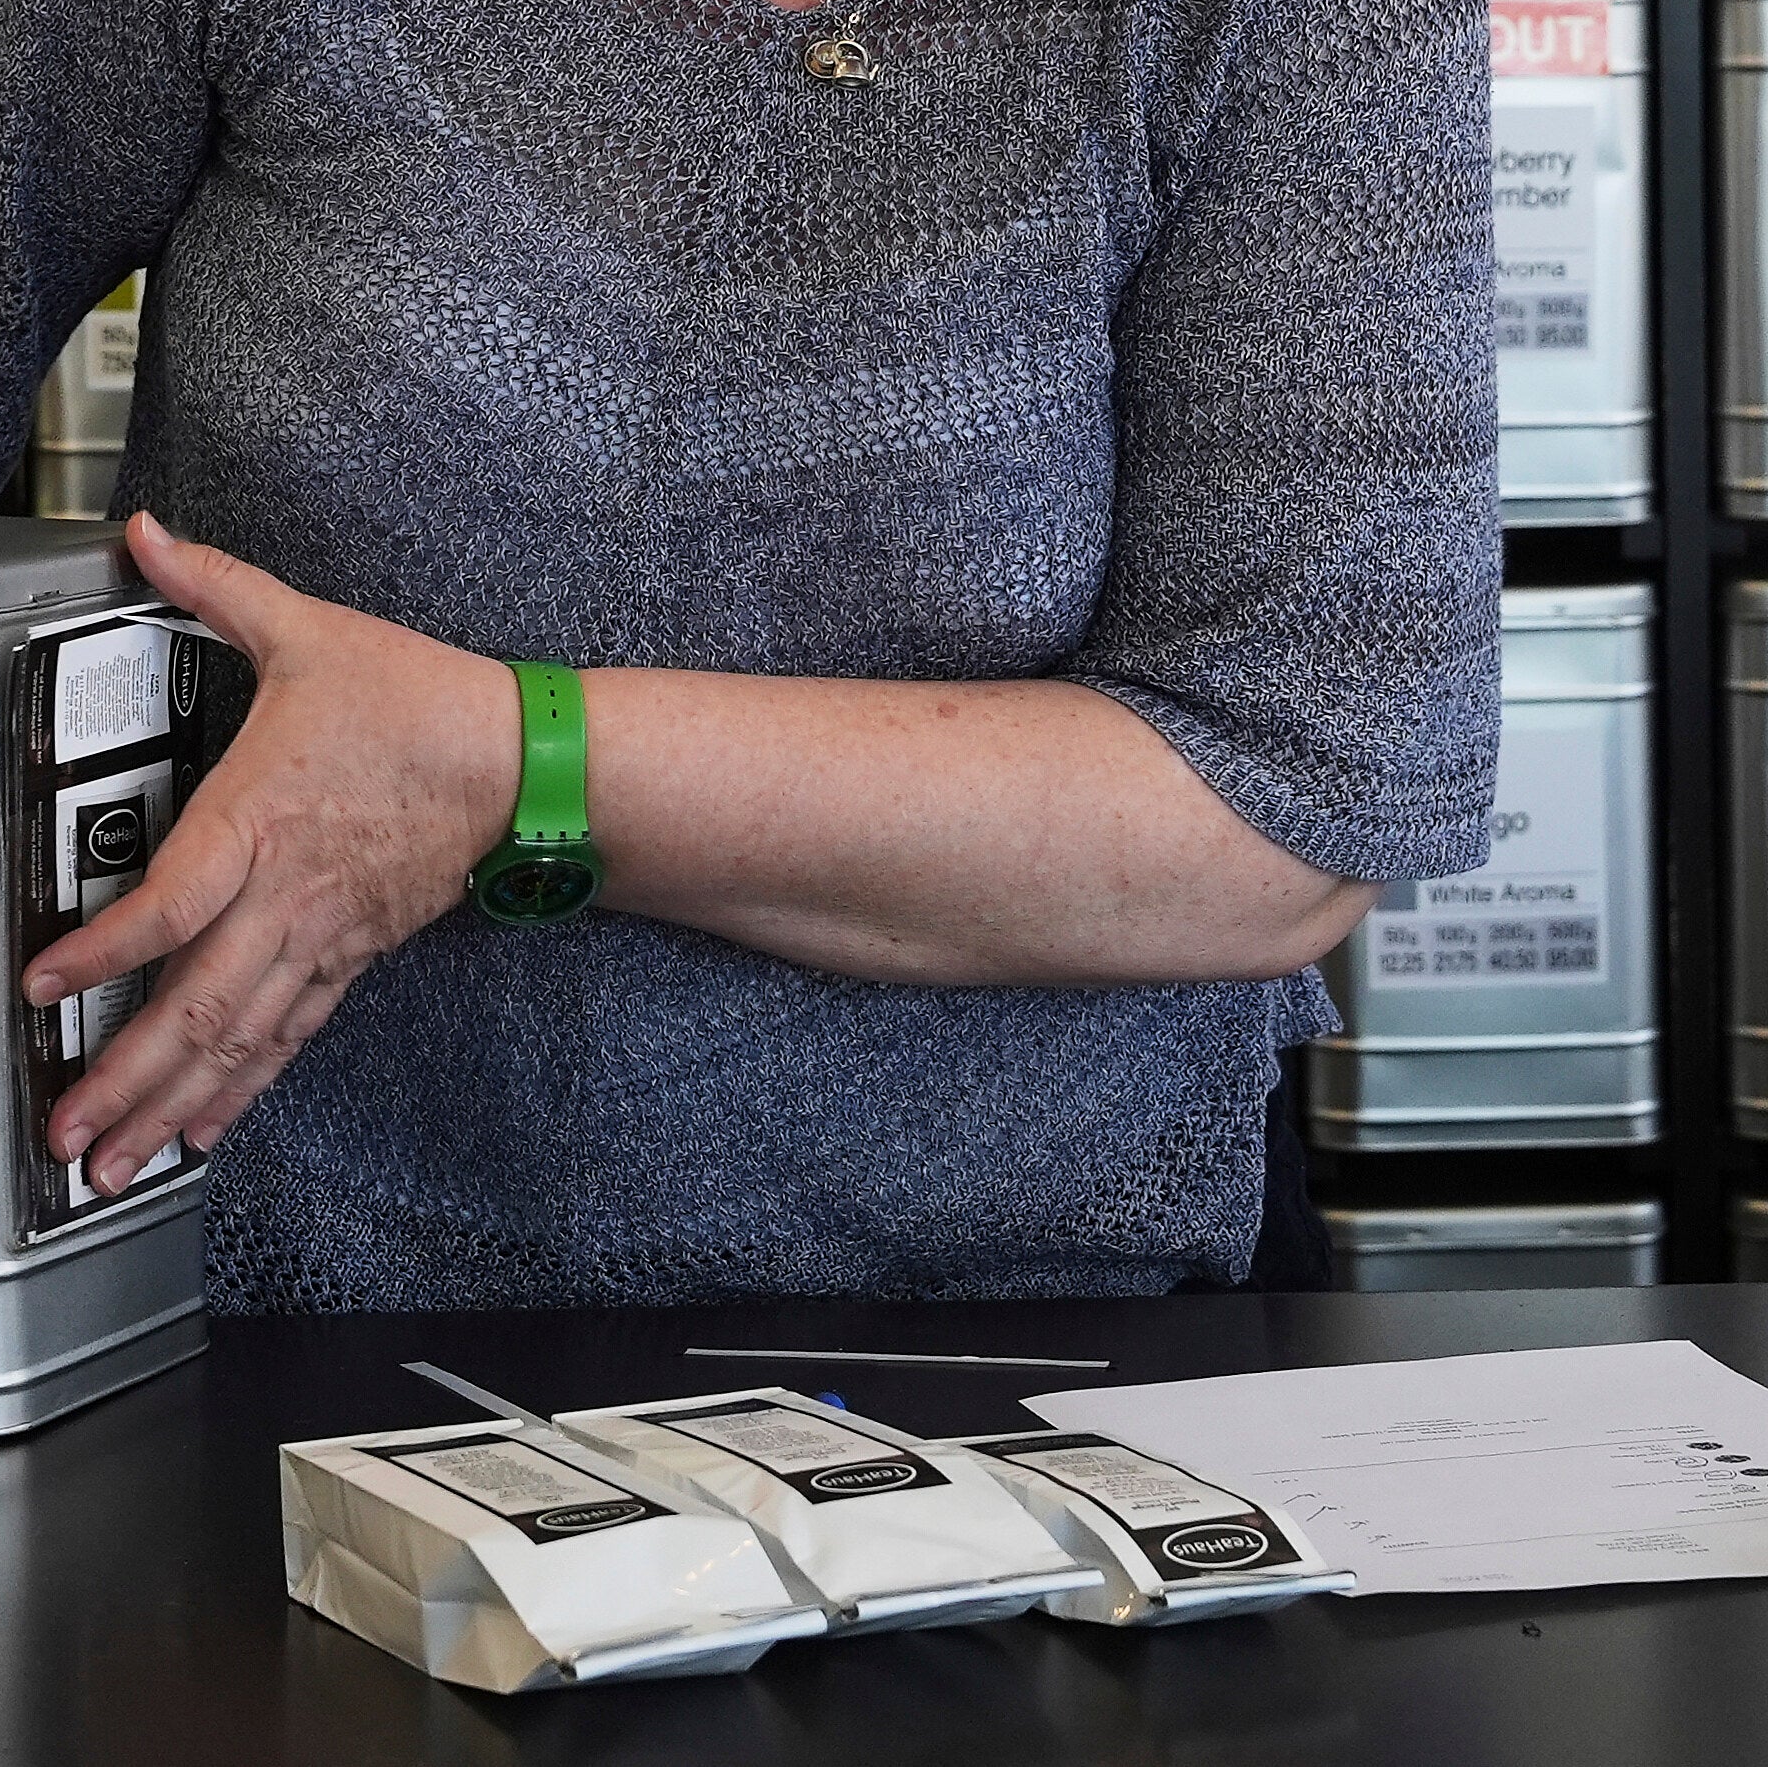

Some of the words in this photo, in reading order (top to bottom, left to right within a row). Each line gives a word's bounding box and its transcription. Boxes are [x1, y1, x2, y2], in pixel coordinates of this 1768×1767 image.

[181, 636, 193, 708] eaHaus
[95, 829, 138, 847] TeaHaus
[822, 1467, 910, 1487] TeaHaus
[545, 1504, 637, 1527] TeaHaus
[1173, 1534, 1262, 1557] TeaHaus
